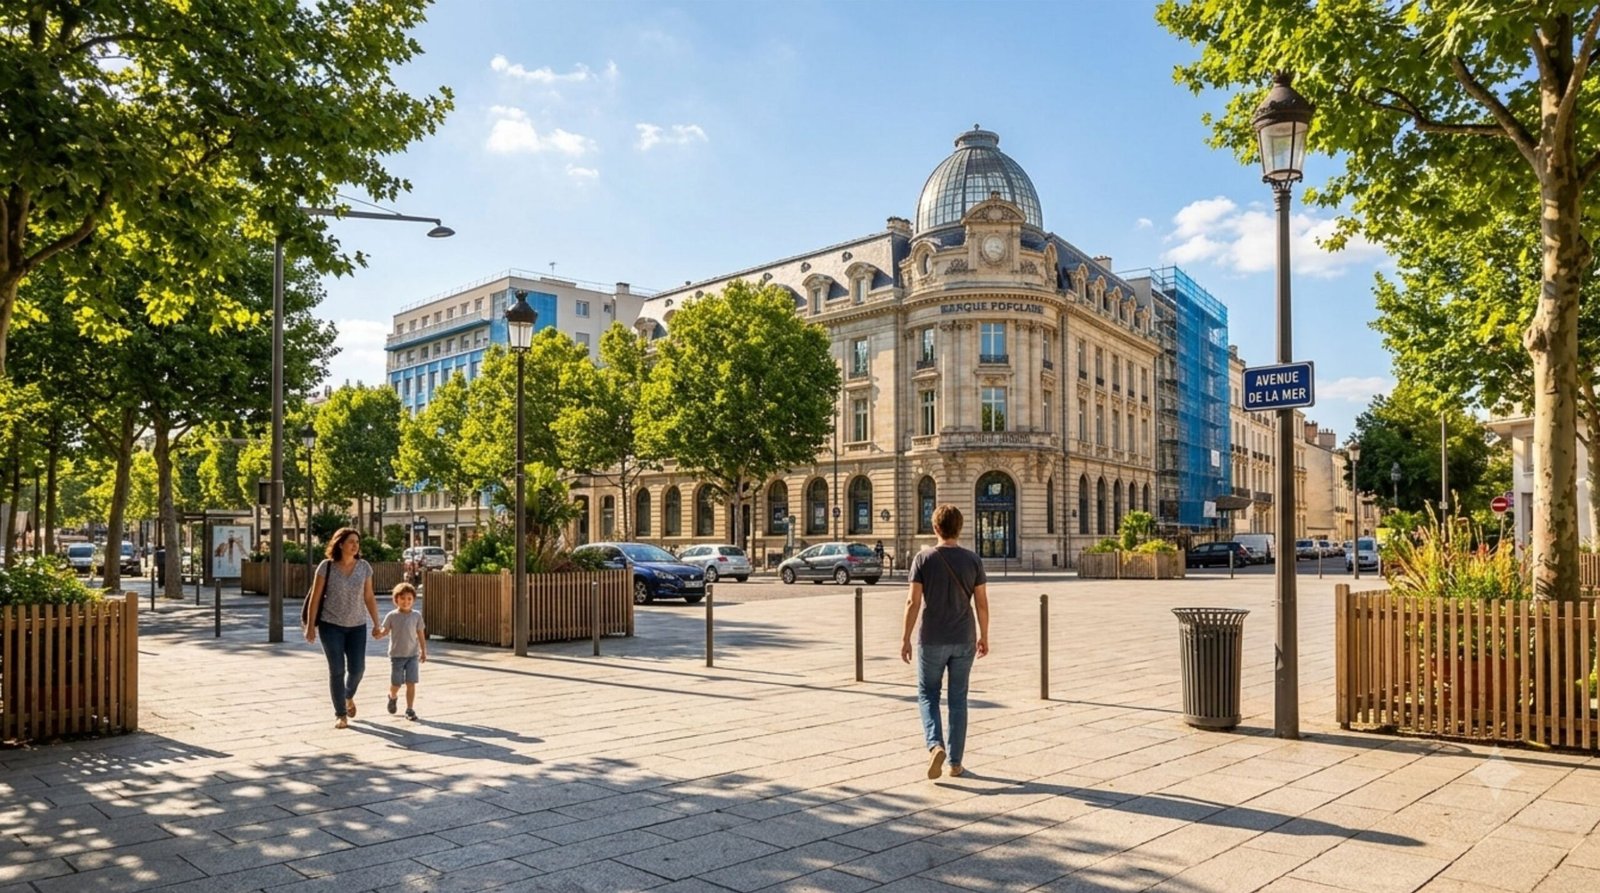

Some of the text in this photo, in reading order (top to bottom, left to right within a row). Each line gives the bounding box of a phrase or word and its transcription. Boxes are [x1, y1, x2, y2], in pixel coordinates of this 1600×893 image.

[1255, 371, 1300, 387] AVENUE
[1248, 387, 1306, 404] DE LA MER
